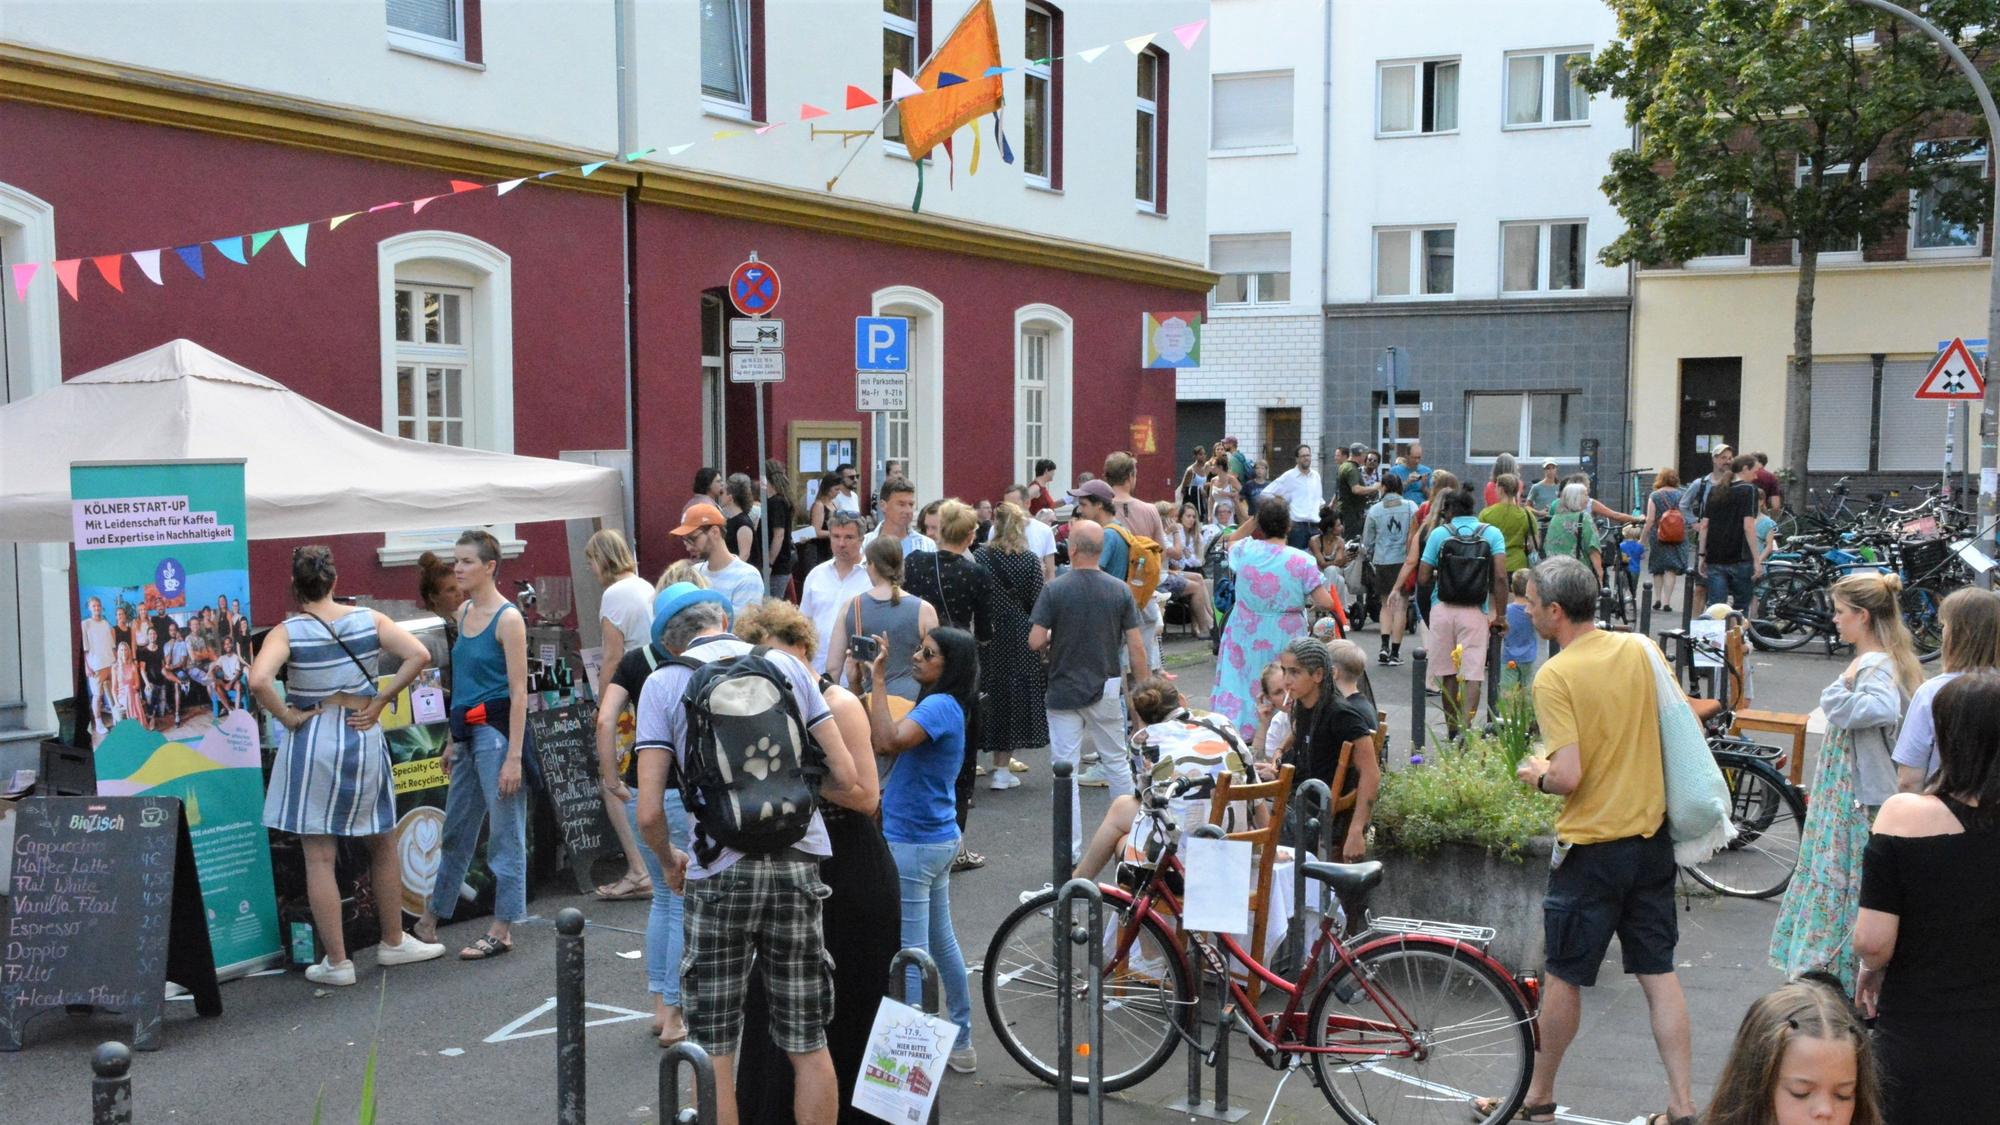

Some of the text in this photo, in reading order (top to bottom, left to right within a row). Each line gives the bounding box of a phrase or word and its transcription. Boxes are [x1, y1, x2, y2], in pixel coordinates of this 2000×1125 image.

[868, 324, 896, 363] P
[872, 377, 904, 385] Parkschein
[1421, 402, 1434, 412] 81
[84, 500, 186, 515] KÖLNER START-UP
[85, 514, 214, 530] Mit Leidenschaft für Kaffee
[86, 527, 232, 546] und Expertise in Nachhaltigkeit
[392, 762, 428, 777] Specialty
[394, 779, 407, 791] mit
[69, 814, 125, 834] BioZisch
[17, 857, 66, 877] Kaffee
[72, 857, 110, 874] Latte
[13, 875, 46, 892] Flat
[54, 878, 100, 894] White
[14, 894, 74, 916] Vanilla
[10, 916, 82, 940] Espresso
[5, 941, 70, 963] Doppio
